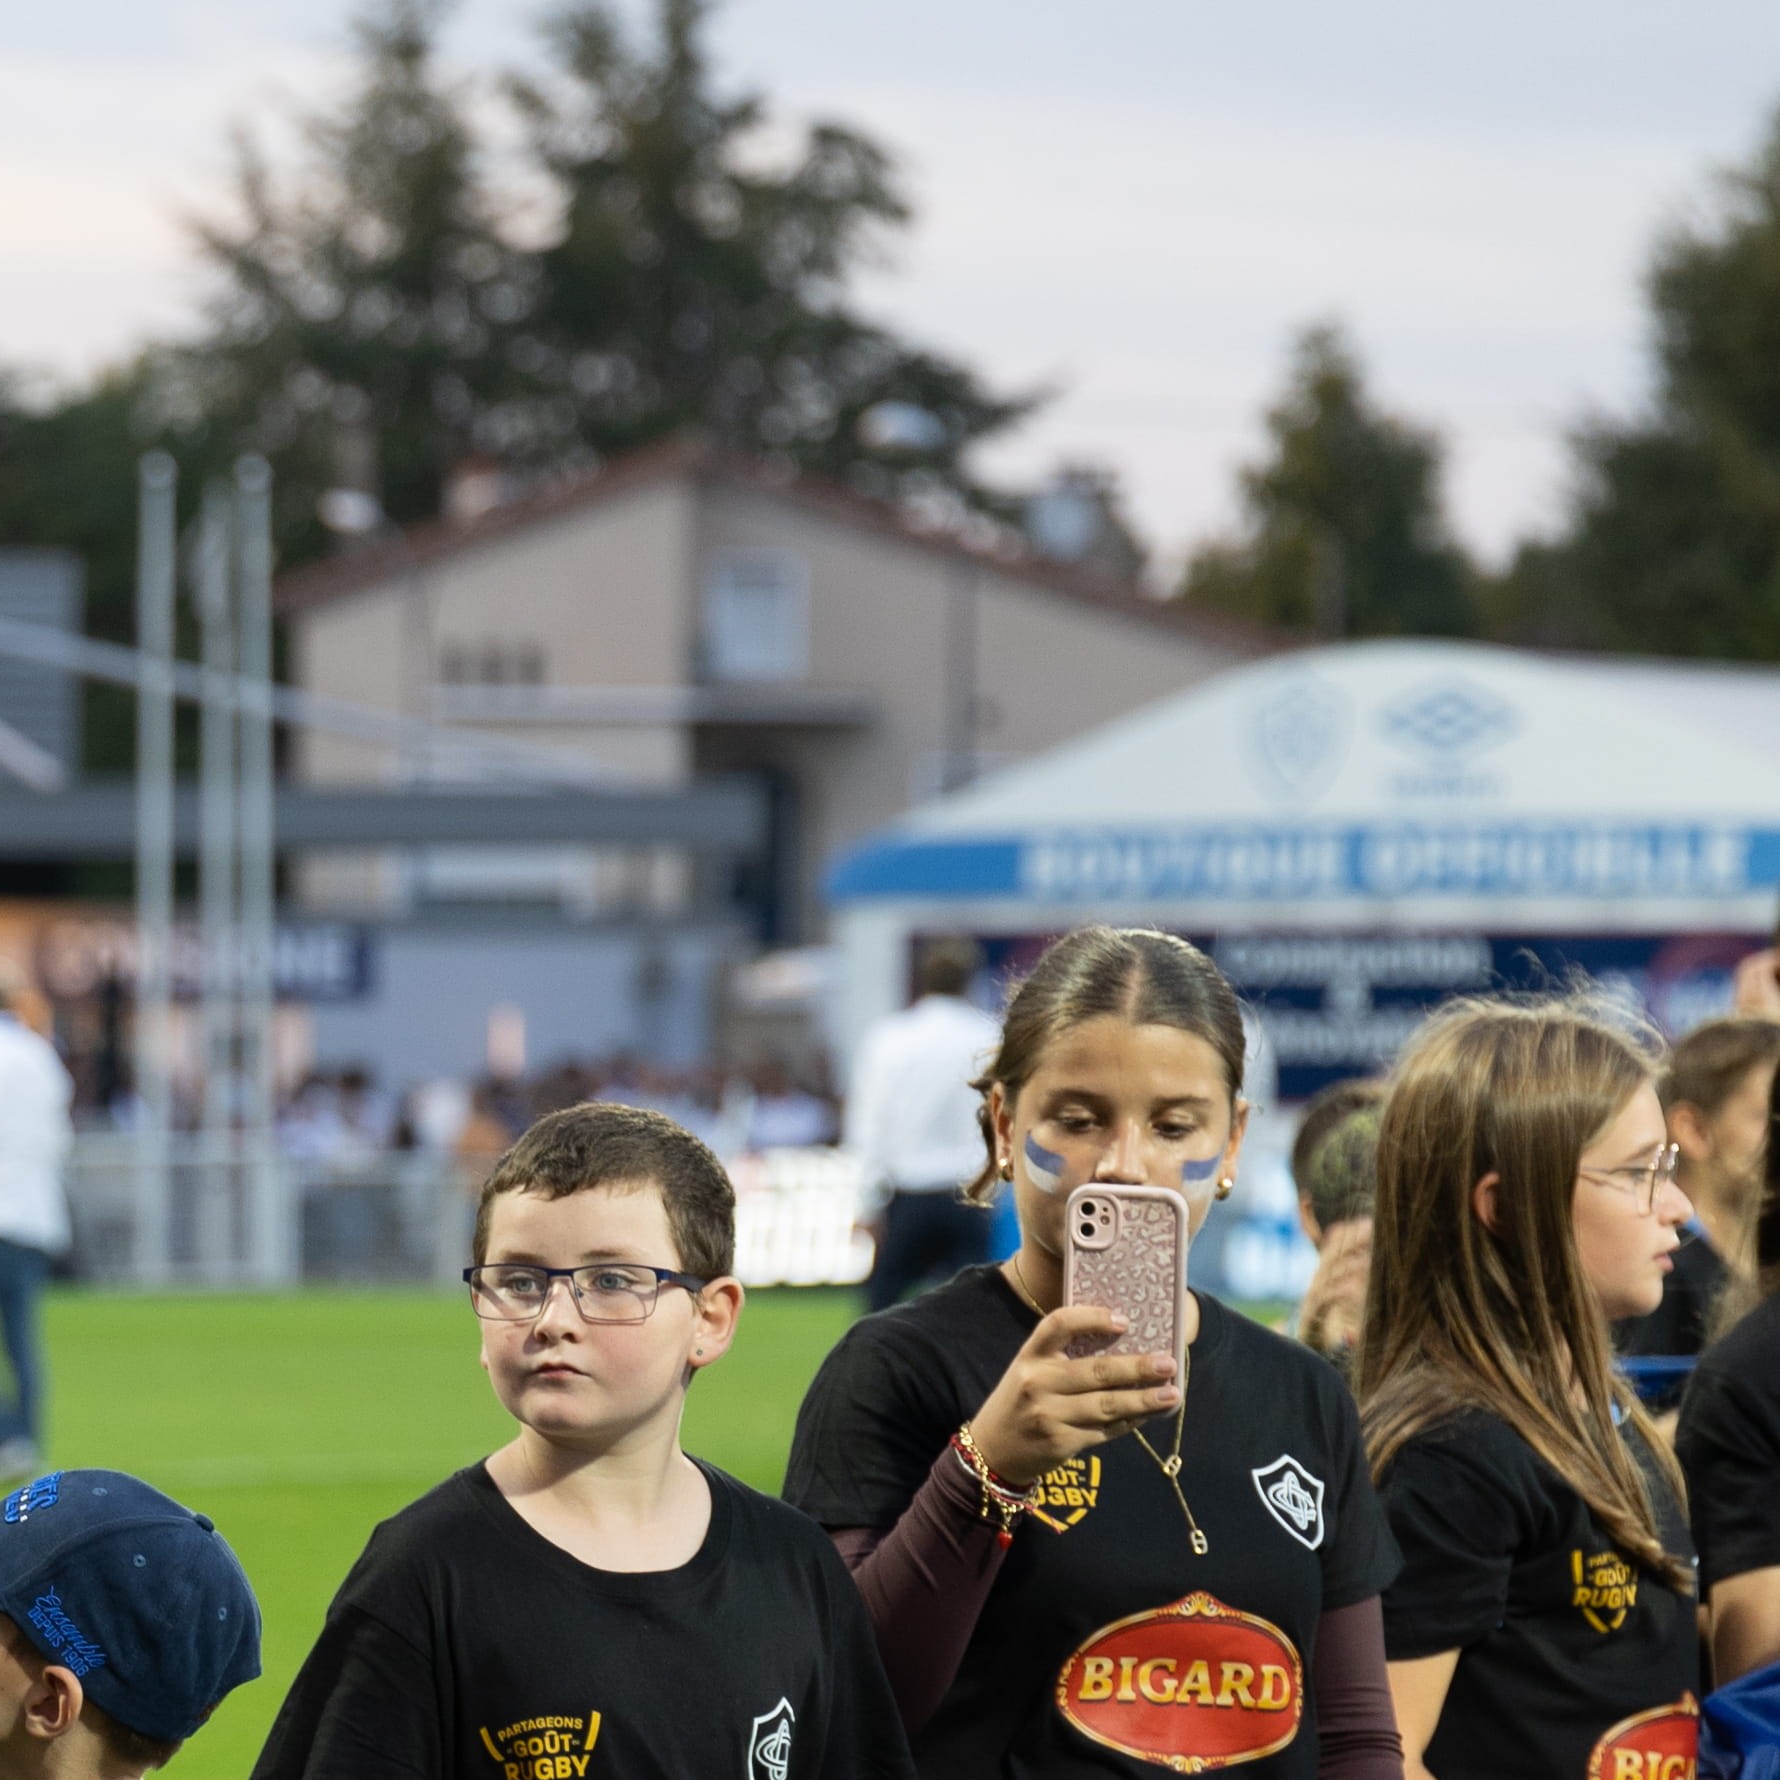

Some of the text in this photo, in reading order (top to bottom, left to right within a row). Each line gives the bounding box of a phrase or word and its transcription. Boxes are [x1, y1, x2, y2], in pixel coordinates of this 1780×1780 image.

[27, 1606, 90, 1678] DEPUIS 1906
[35, 1585, 108, 1668] Ensemble
[1078, 1656, 1291, 1711] BIGARD
[498, 1716, 583, 1742] PARTAGEONS
